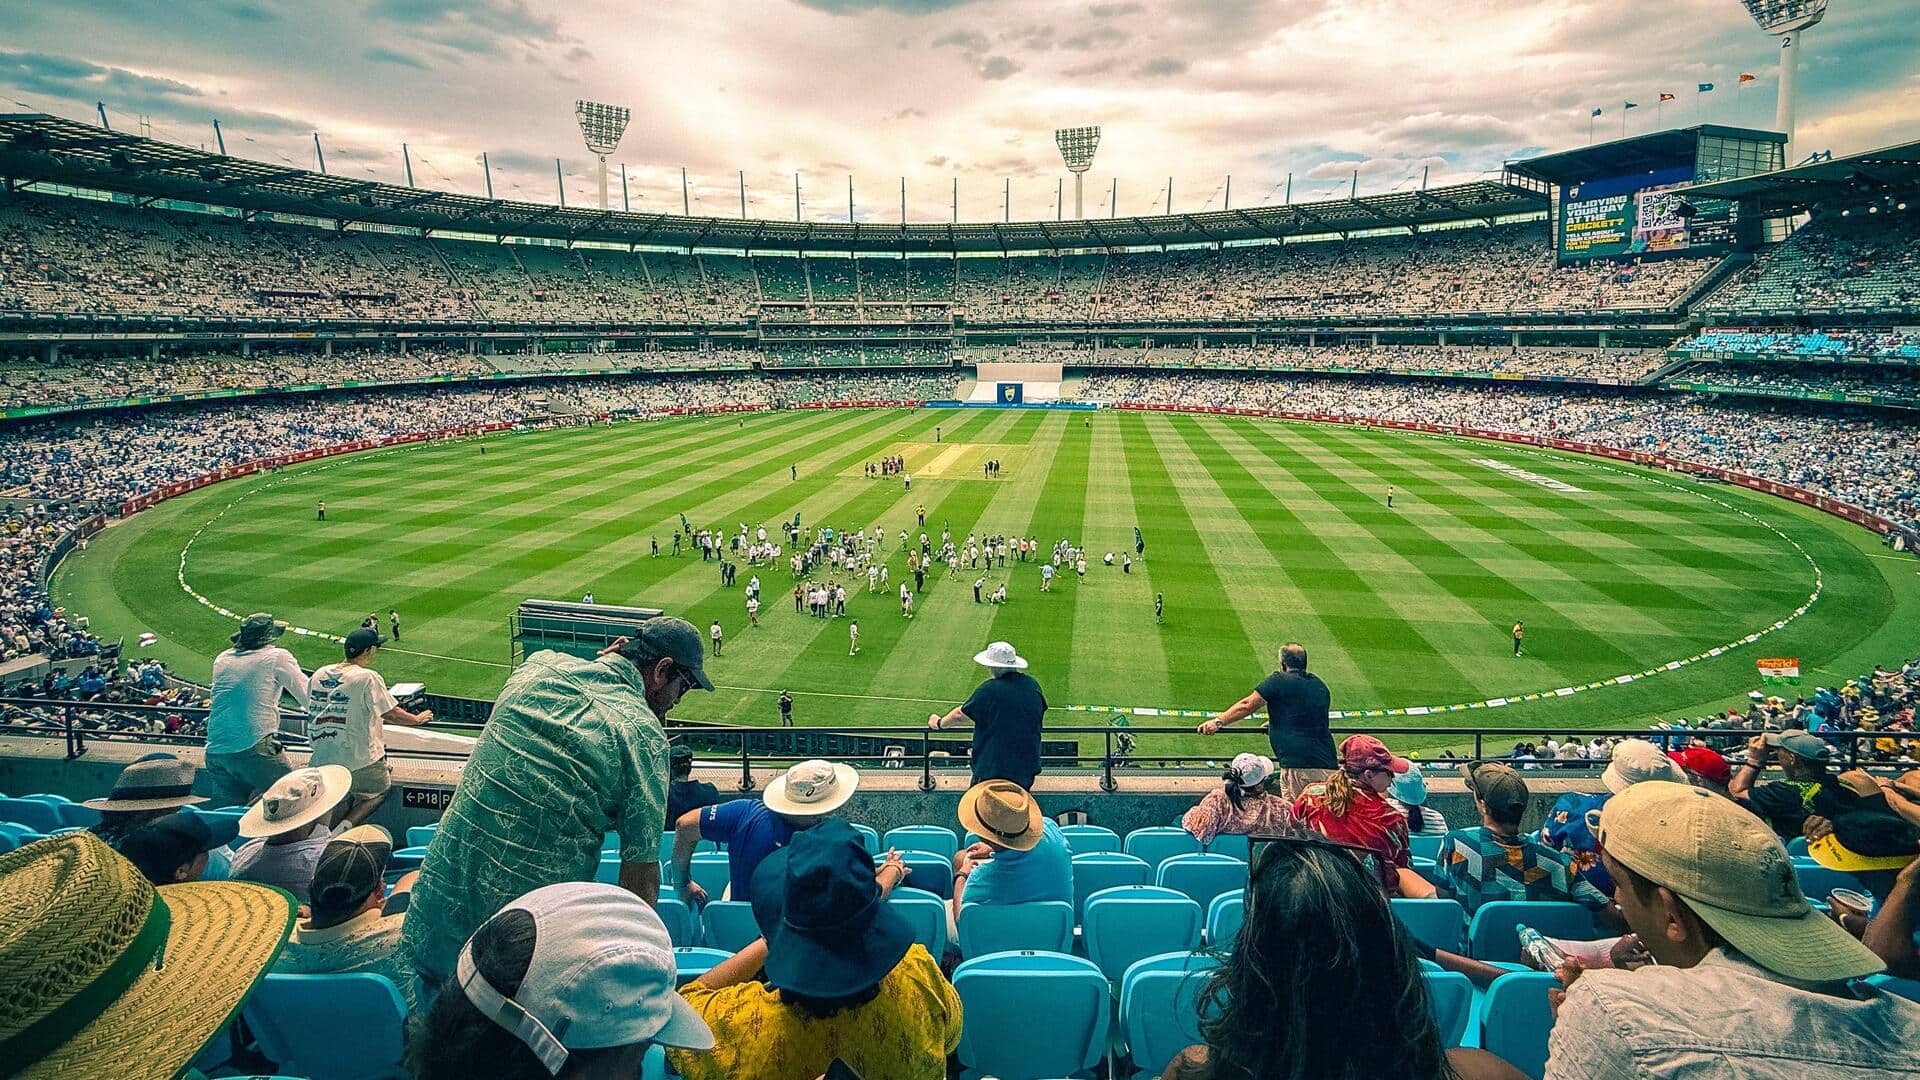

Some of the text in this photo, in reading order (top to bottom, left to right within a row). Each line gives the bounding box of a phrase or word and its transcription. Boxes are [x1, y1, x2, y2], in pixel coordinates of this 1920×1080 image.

[1782, 36, 1791, 48] 2
[1566, 195, 1628, 211] ENJOYING
[1566, 203, 1625, 218] YOUR DAY
[1565, 217, 1625, 232] CRICKET?
[1566, 213, 1607, 225] AT THE
[417, 792, 438, 805] P18
